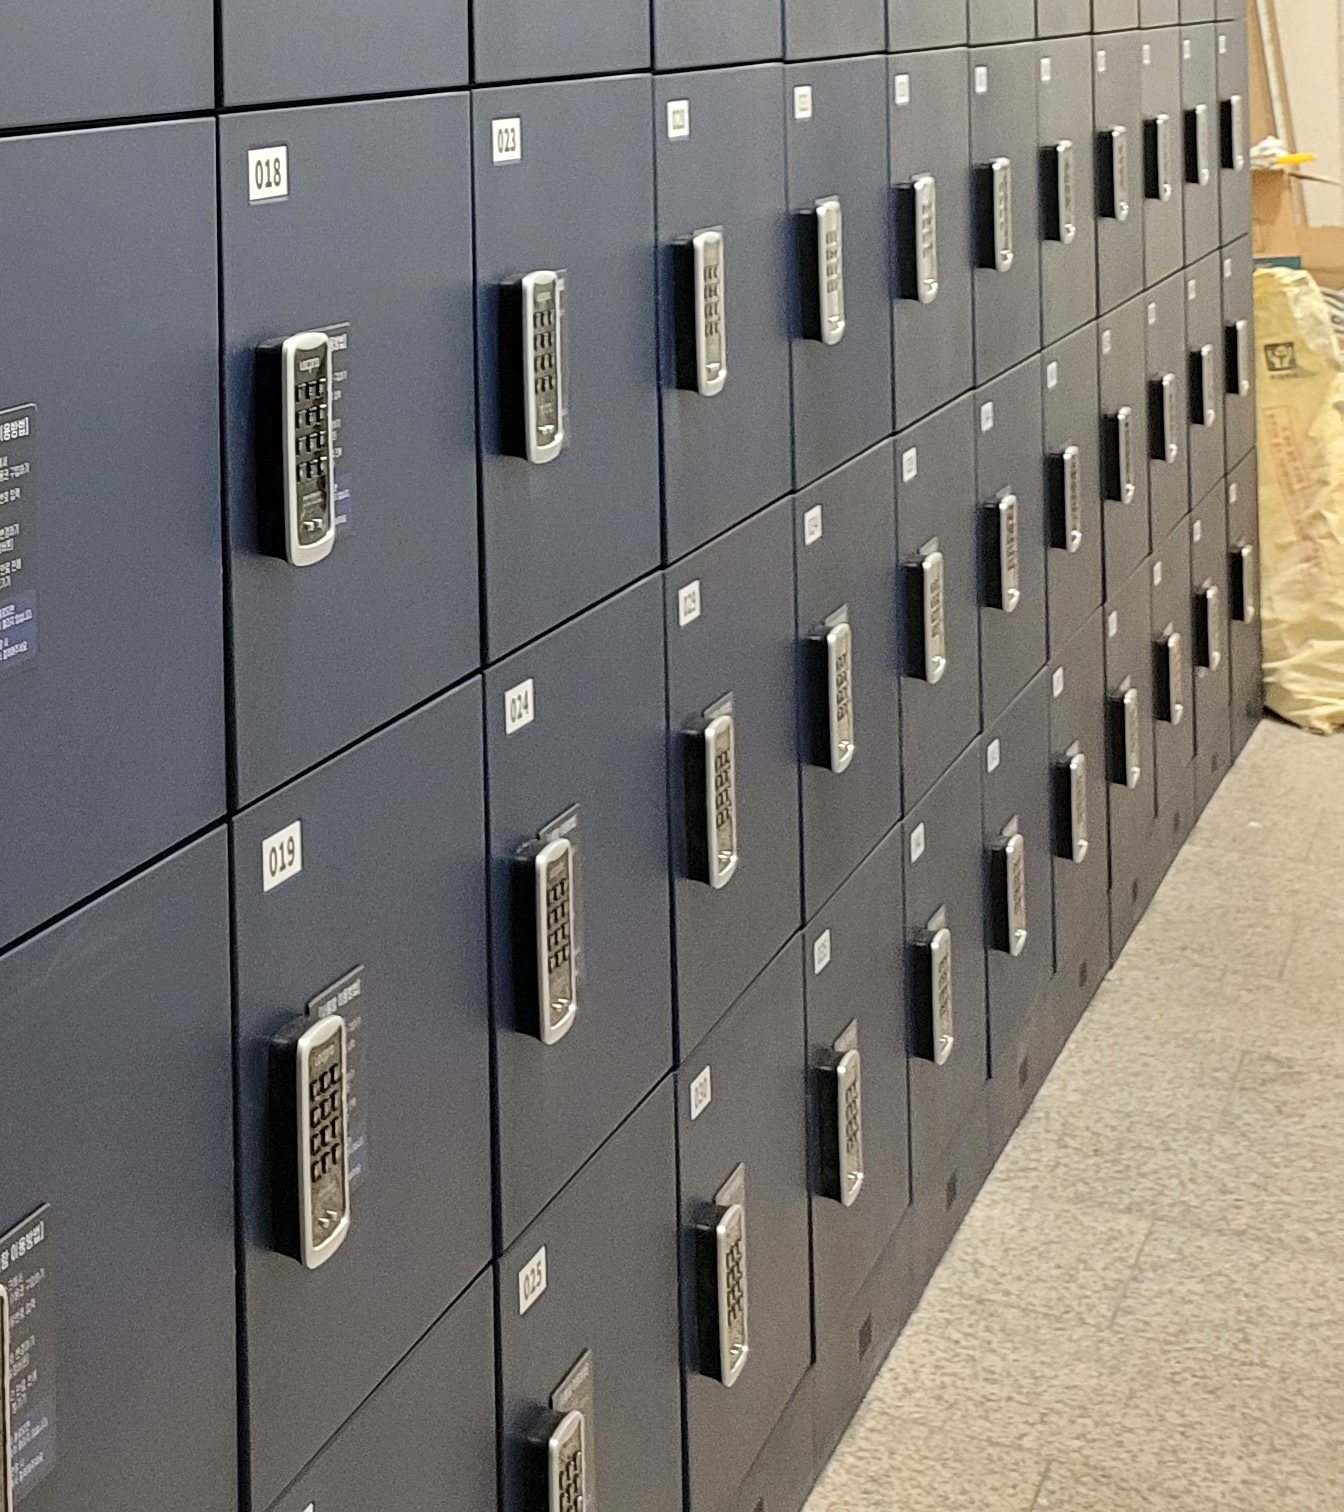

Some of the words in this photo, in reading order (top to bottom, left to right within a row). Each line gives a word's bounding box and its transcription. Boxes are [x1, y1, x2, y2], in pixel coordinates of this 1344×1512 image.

[497, 127, 517, 153] 023
[255, 157, 281, 189] 018
[510, 690, 529, 722] 024
[269, 836, 295, 876] 019
[523, 1260, 542, 1301] 025
